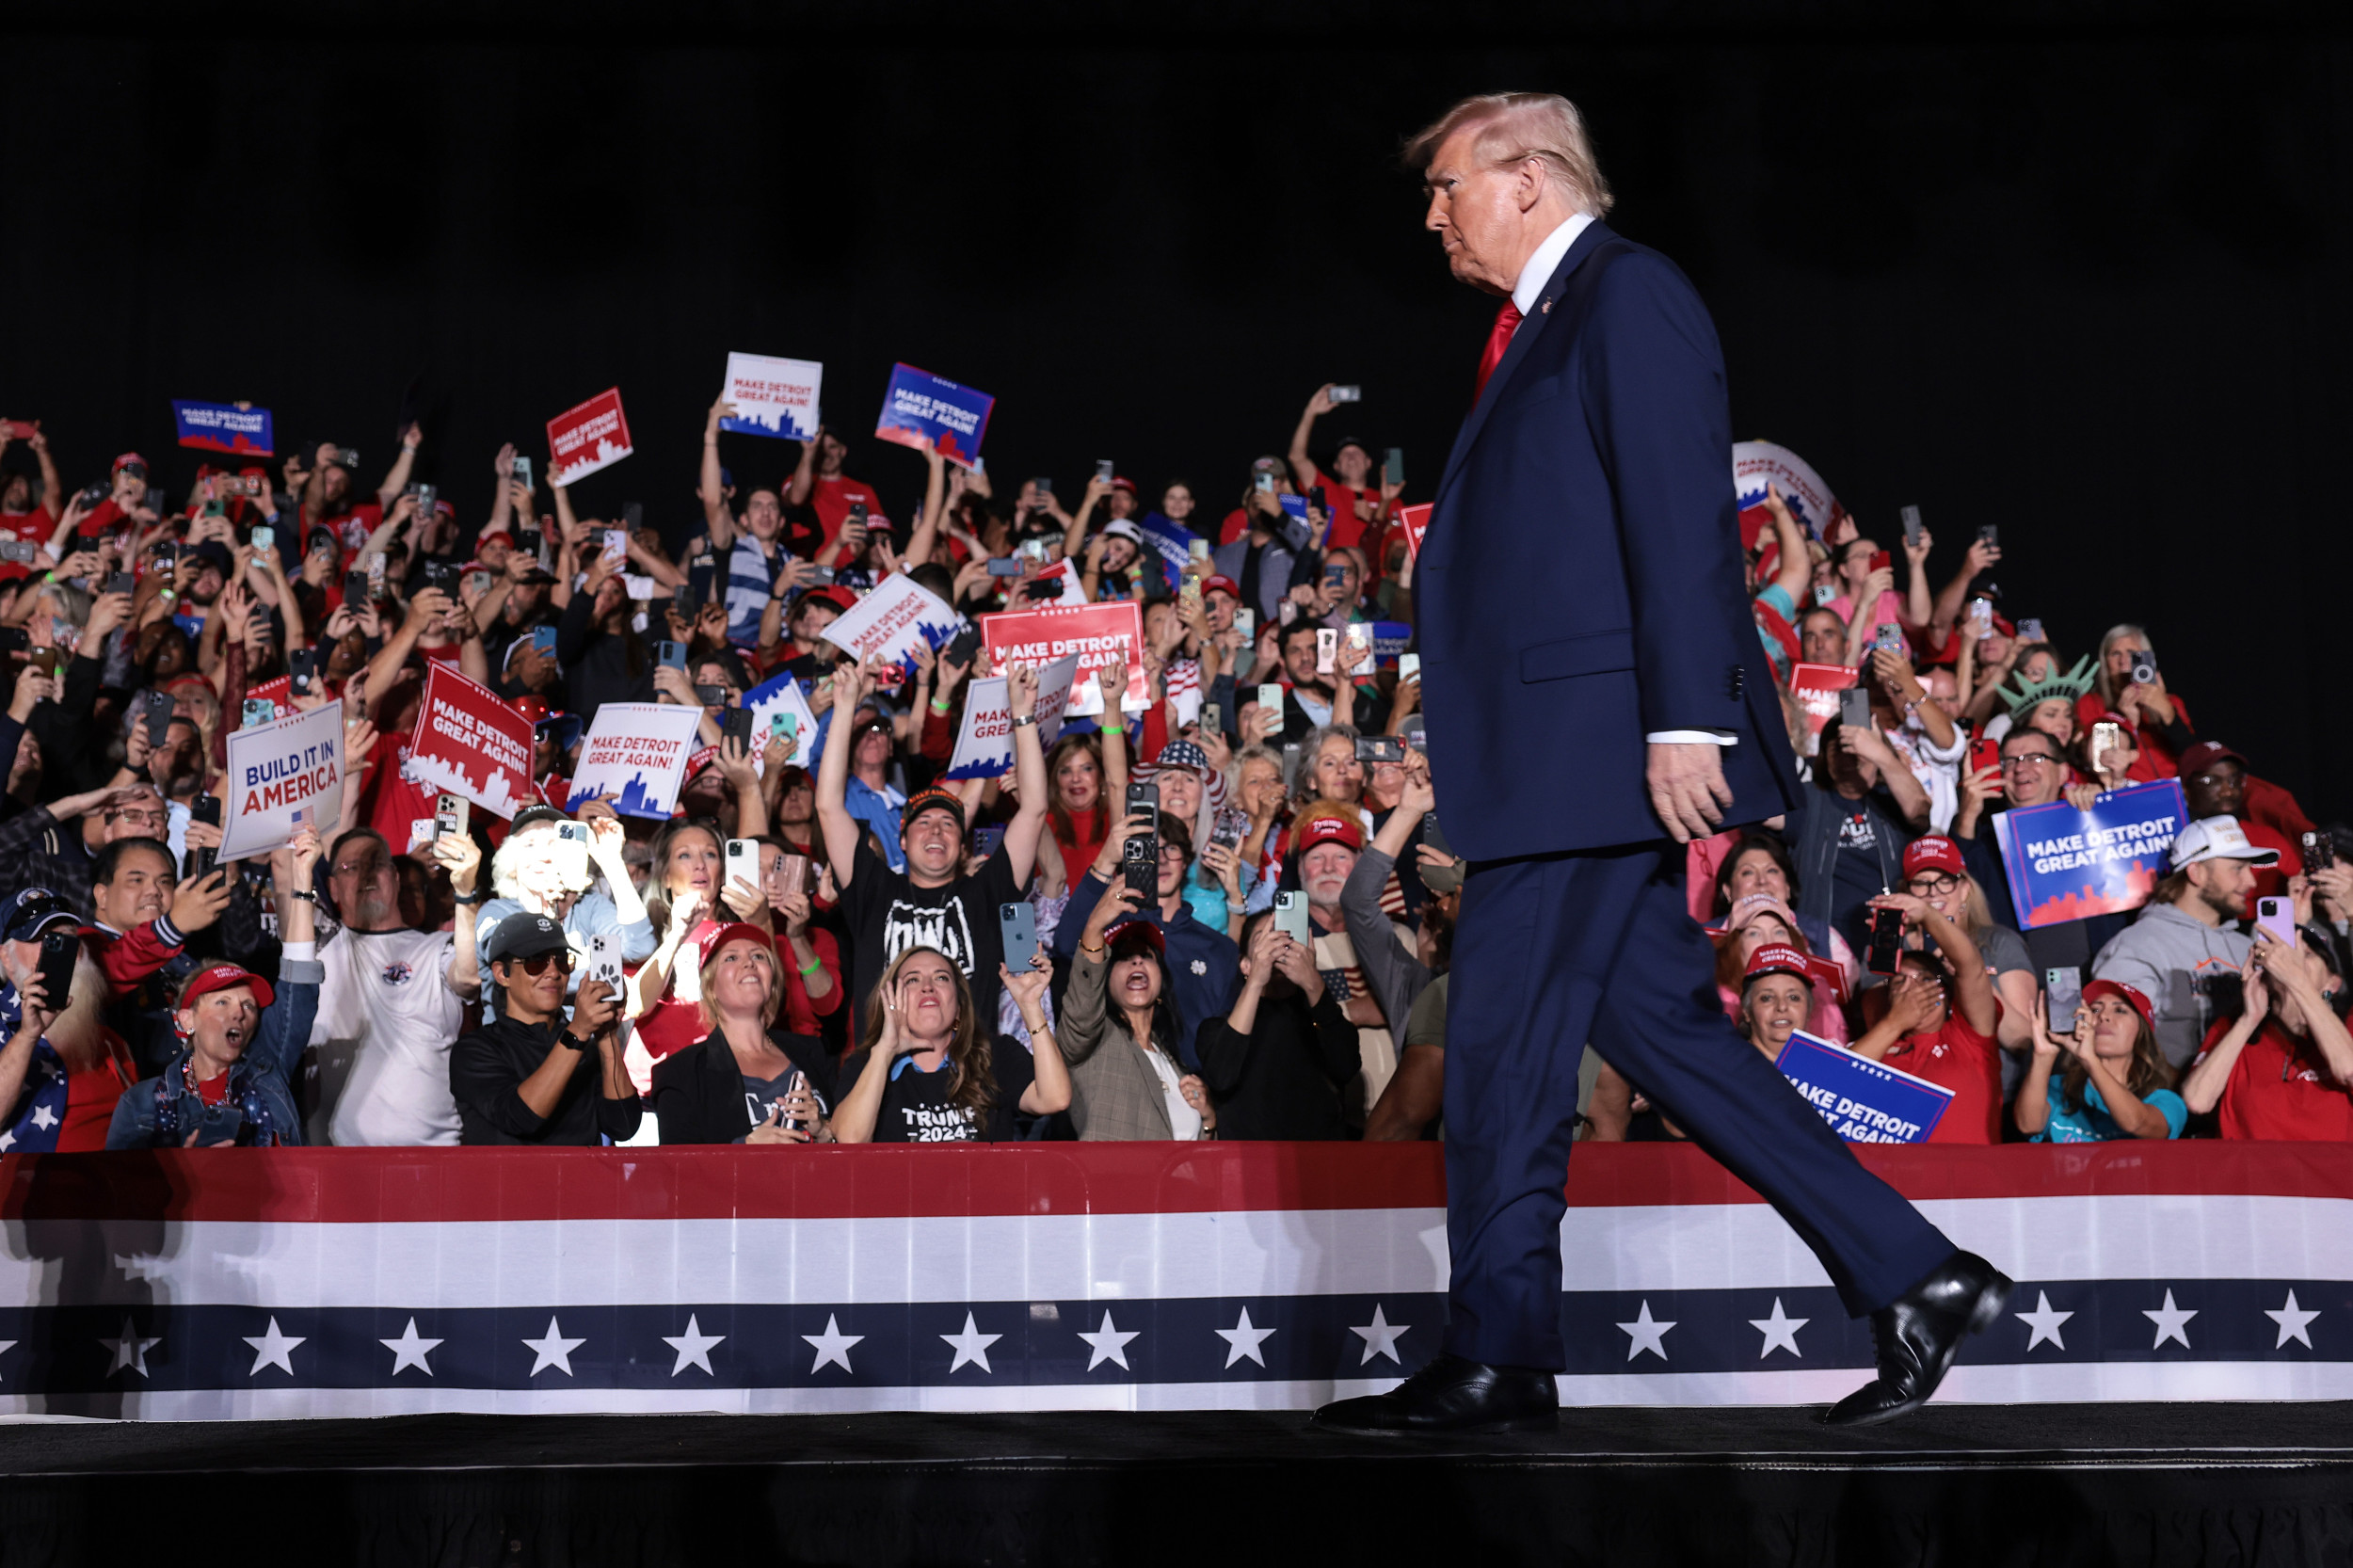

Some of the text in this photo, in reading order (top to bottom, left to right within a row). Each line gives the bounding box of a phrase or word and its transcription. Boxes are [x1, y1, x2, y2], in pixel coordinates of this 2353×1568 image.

[894, 399, 936, 421] GREAT
[895, 387, 980, 425] MAKE DETROIT
[850, 591, 920, 649] MAKE DETROIT
[1051, 633, 1132, 656] DETROIT
[432, 696, 529, 762] MAKE DETROIT
[432, 715, 527, 777] GREAT AGAIN!
[591, 736, 681, 754] MAKE DETROIT
[246, 739, 334, 787] BUILD IT IN
[588, 751, 674, 770] GREAT AGAIN!
[241, 761, 338, 816] AMERICA
[2026, 816, 2175, 859] MAKE DETROIT
[2034, 848, 2099, 875] GREAT
[1835, 1096, 1921, 1141] DETROIT
